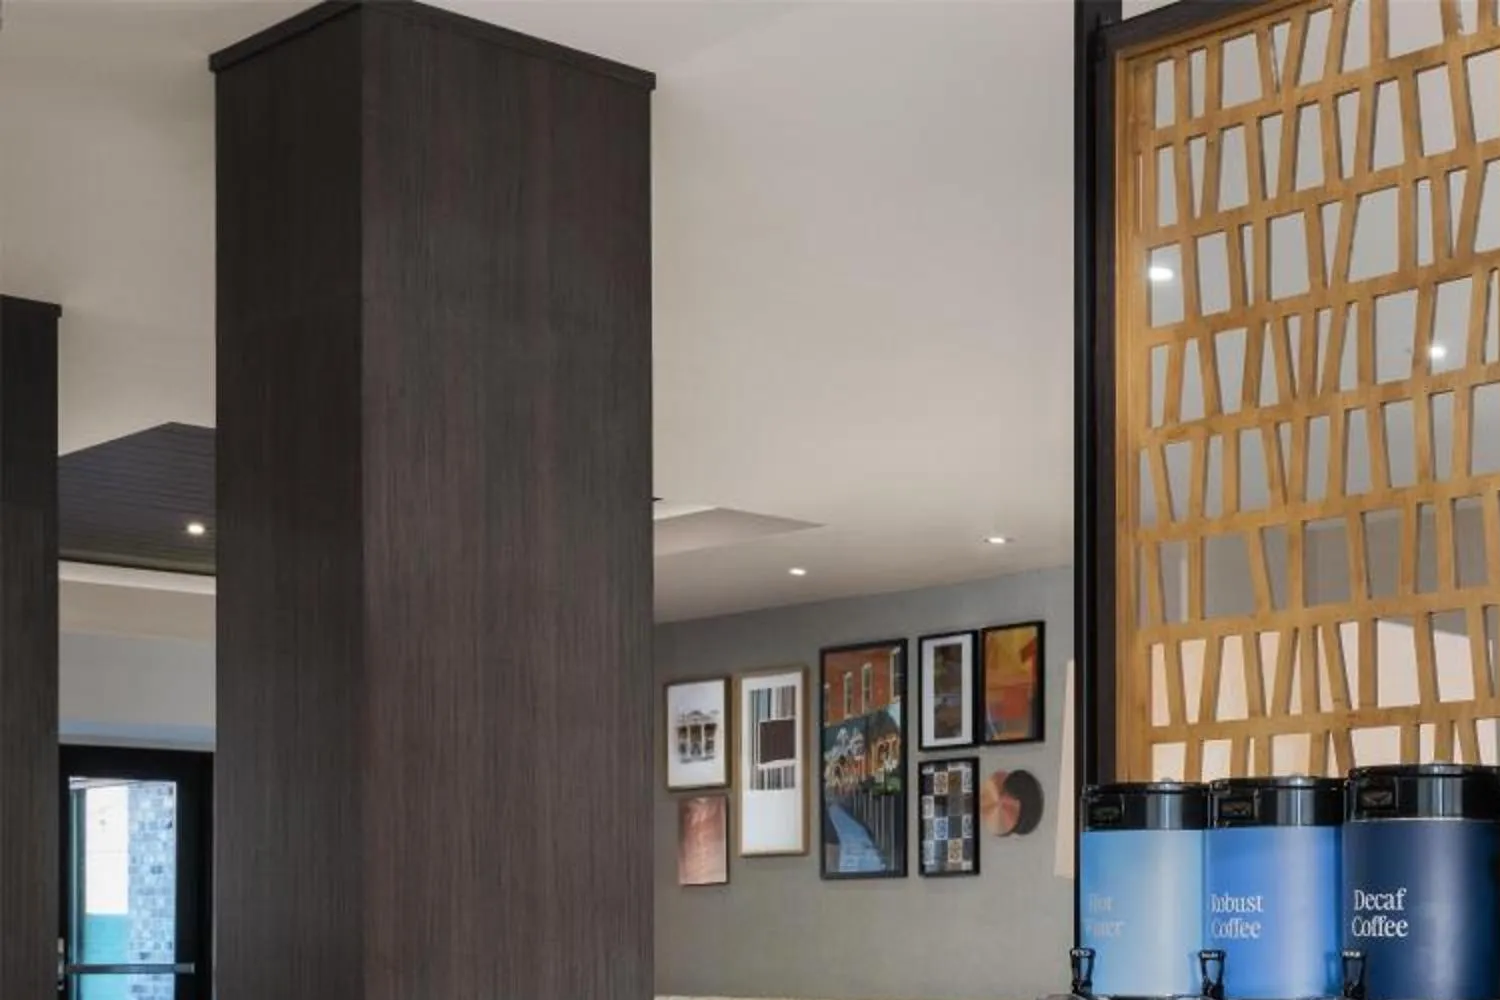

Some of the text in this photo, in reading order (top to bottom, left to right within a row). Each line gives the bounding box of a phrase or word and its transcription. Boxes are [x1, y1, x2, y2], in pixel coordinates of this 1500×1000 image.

[1353, 887, 1407, 911] Decaf
[1211, 917, 1262, 939] Coffee
[1351, 915, 1409, 937] Coffee
